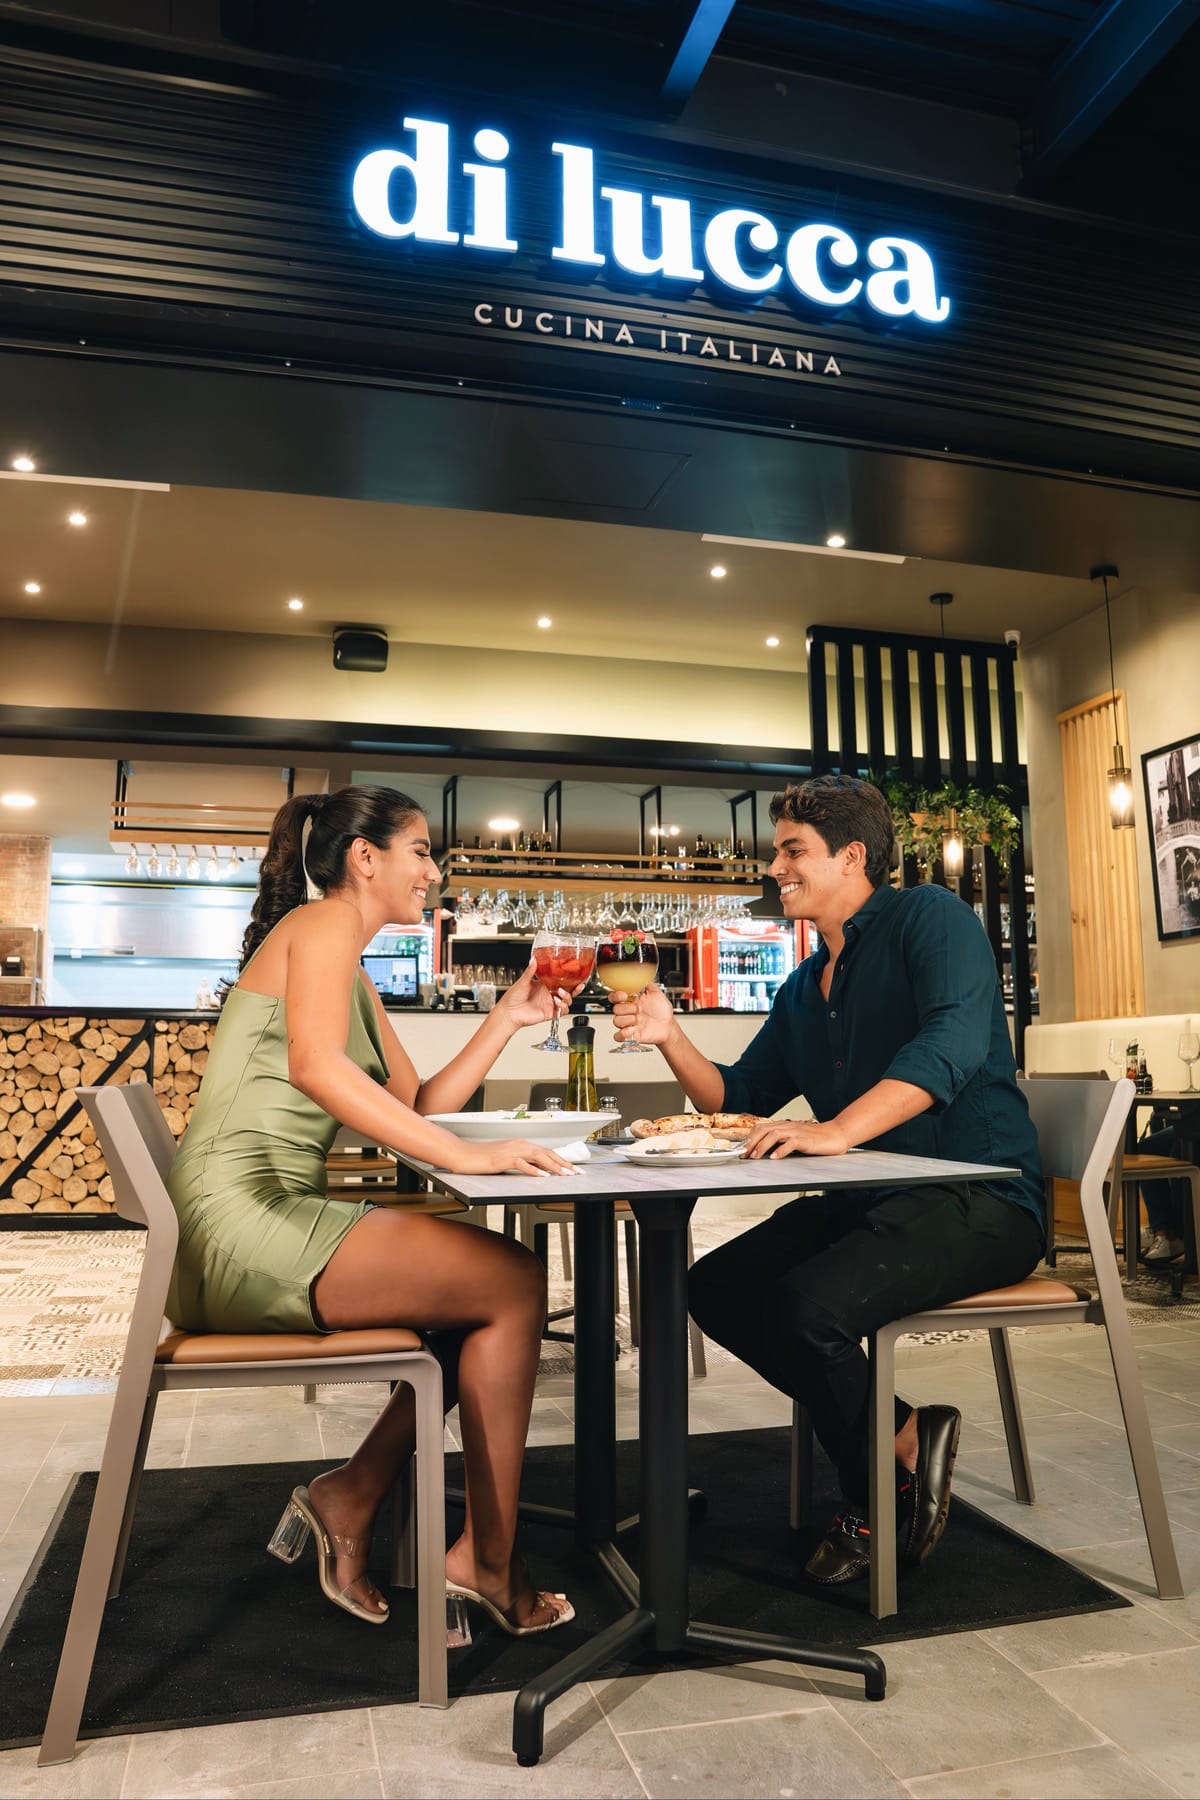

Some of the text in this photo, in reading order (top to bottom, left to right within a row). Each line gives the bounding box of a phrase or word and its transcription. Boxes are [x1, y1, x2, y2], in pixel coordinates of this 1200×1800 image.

[352, 116, 950, 323] di lucca
[474, 303, 842, 377] CUCINA ITALIANA
